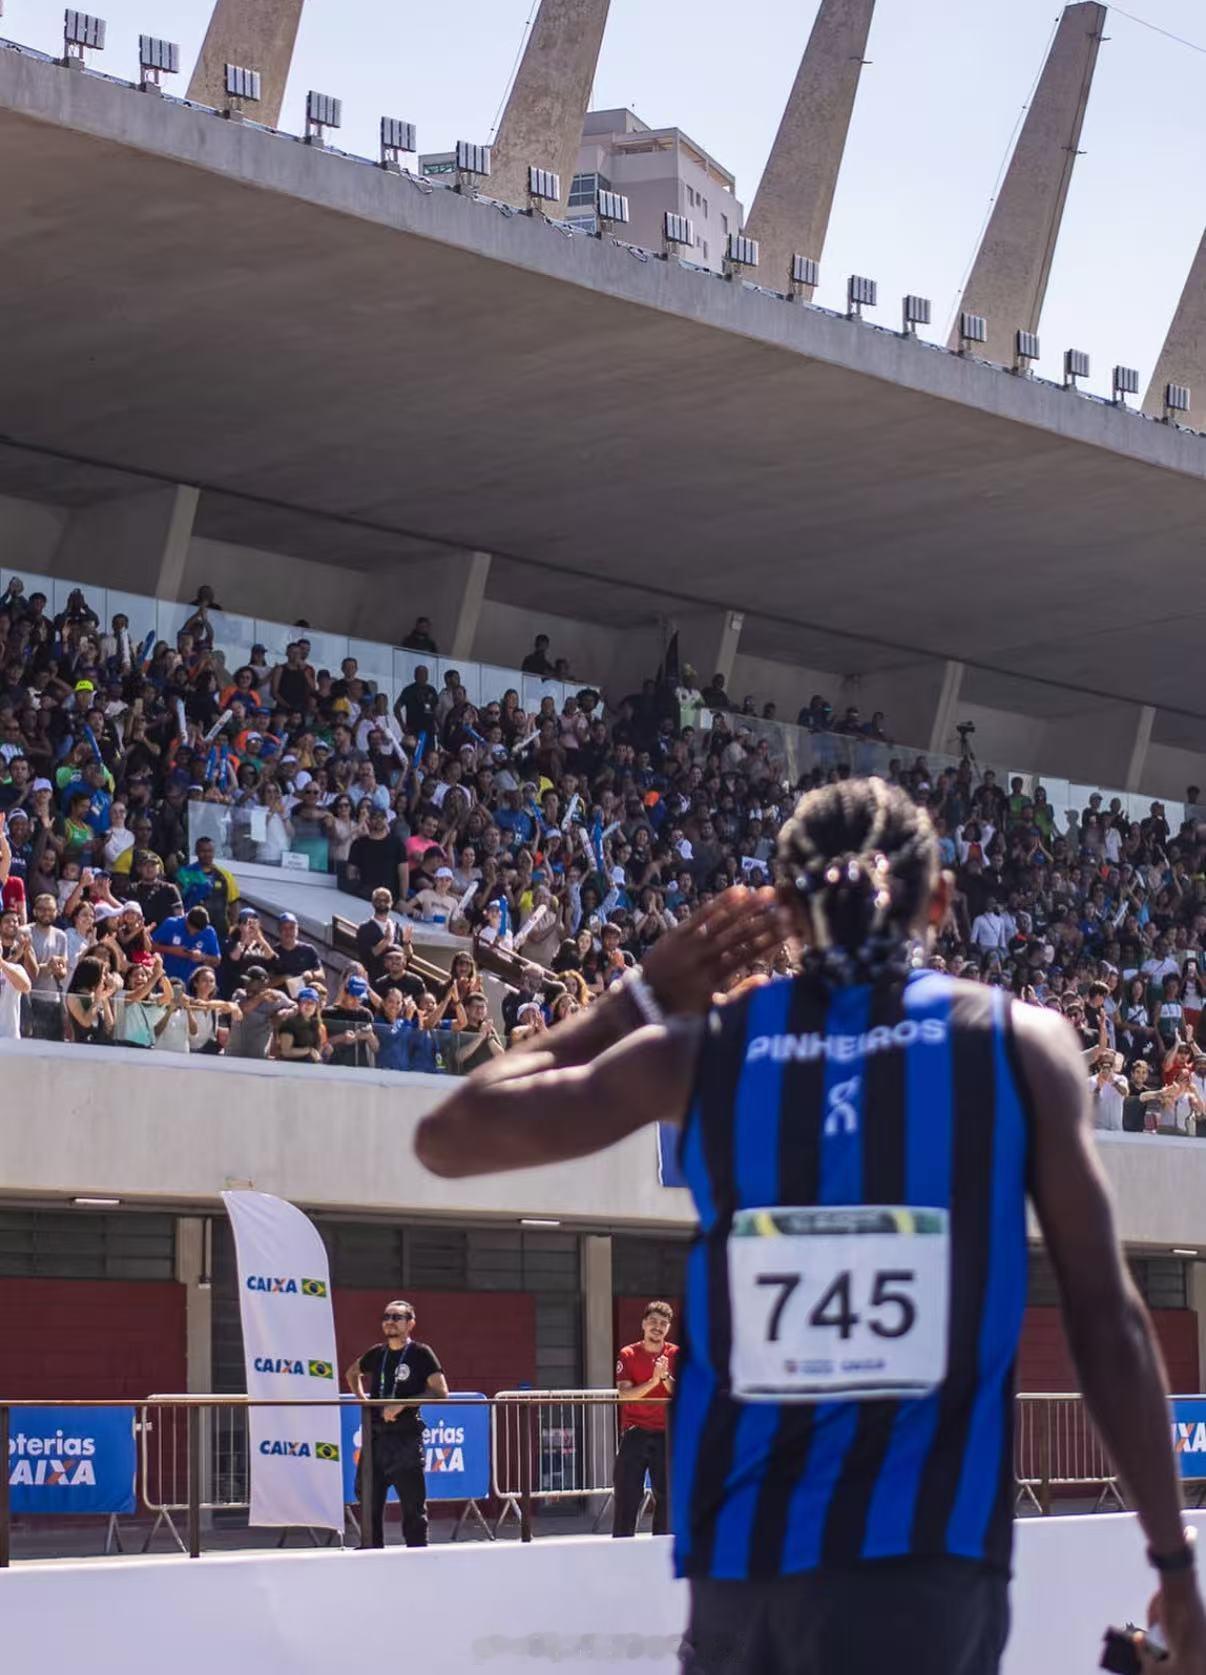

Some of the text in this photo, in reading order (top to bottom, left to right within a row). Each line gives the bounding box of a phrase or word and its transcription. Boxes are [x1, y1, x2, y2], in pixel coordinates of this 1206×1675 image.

[746, 1017, 946, 1063] PINHEIROS
[247, 1276, 298, 1294] CAIXA
[755, 1268, 916, 1342] 745
[254, 1358, 304, 1375] CAIXA
[260, 1440, 311, 1457] CAIXA
[8, 1460, 96, 1485] AIXA
